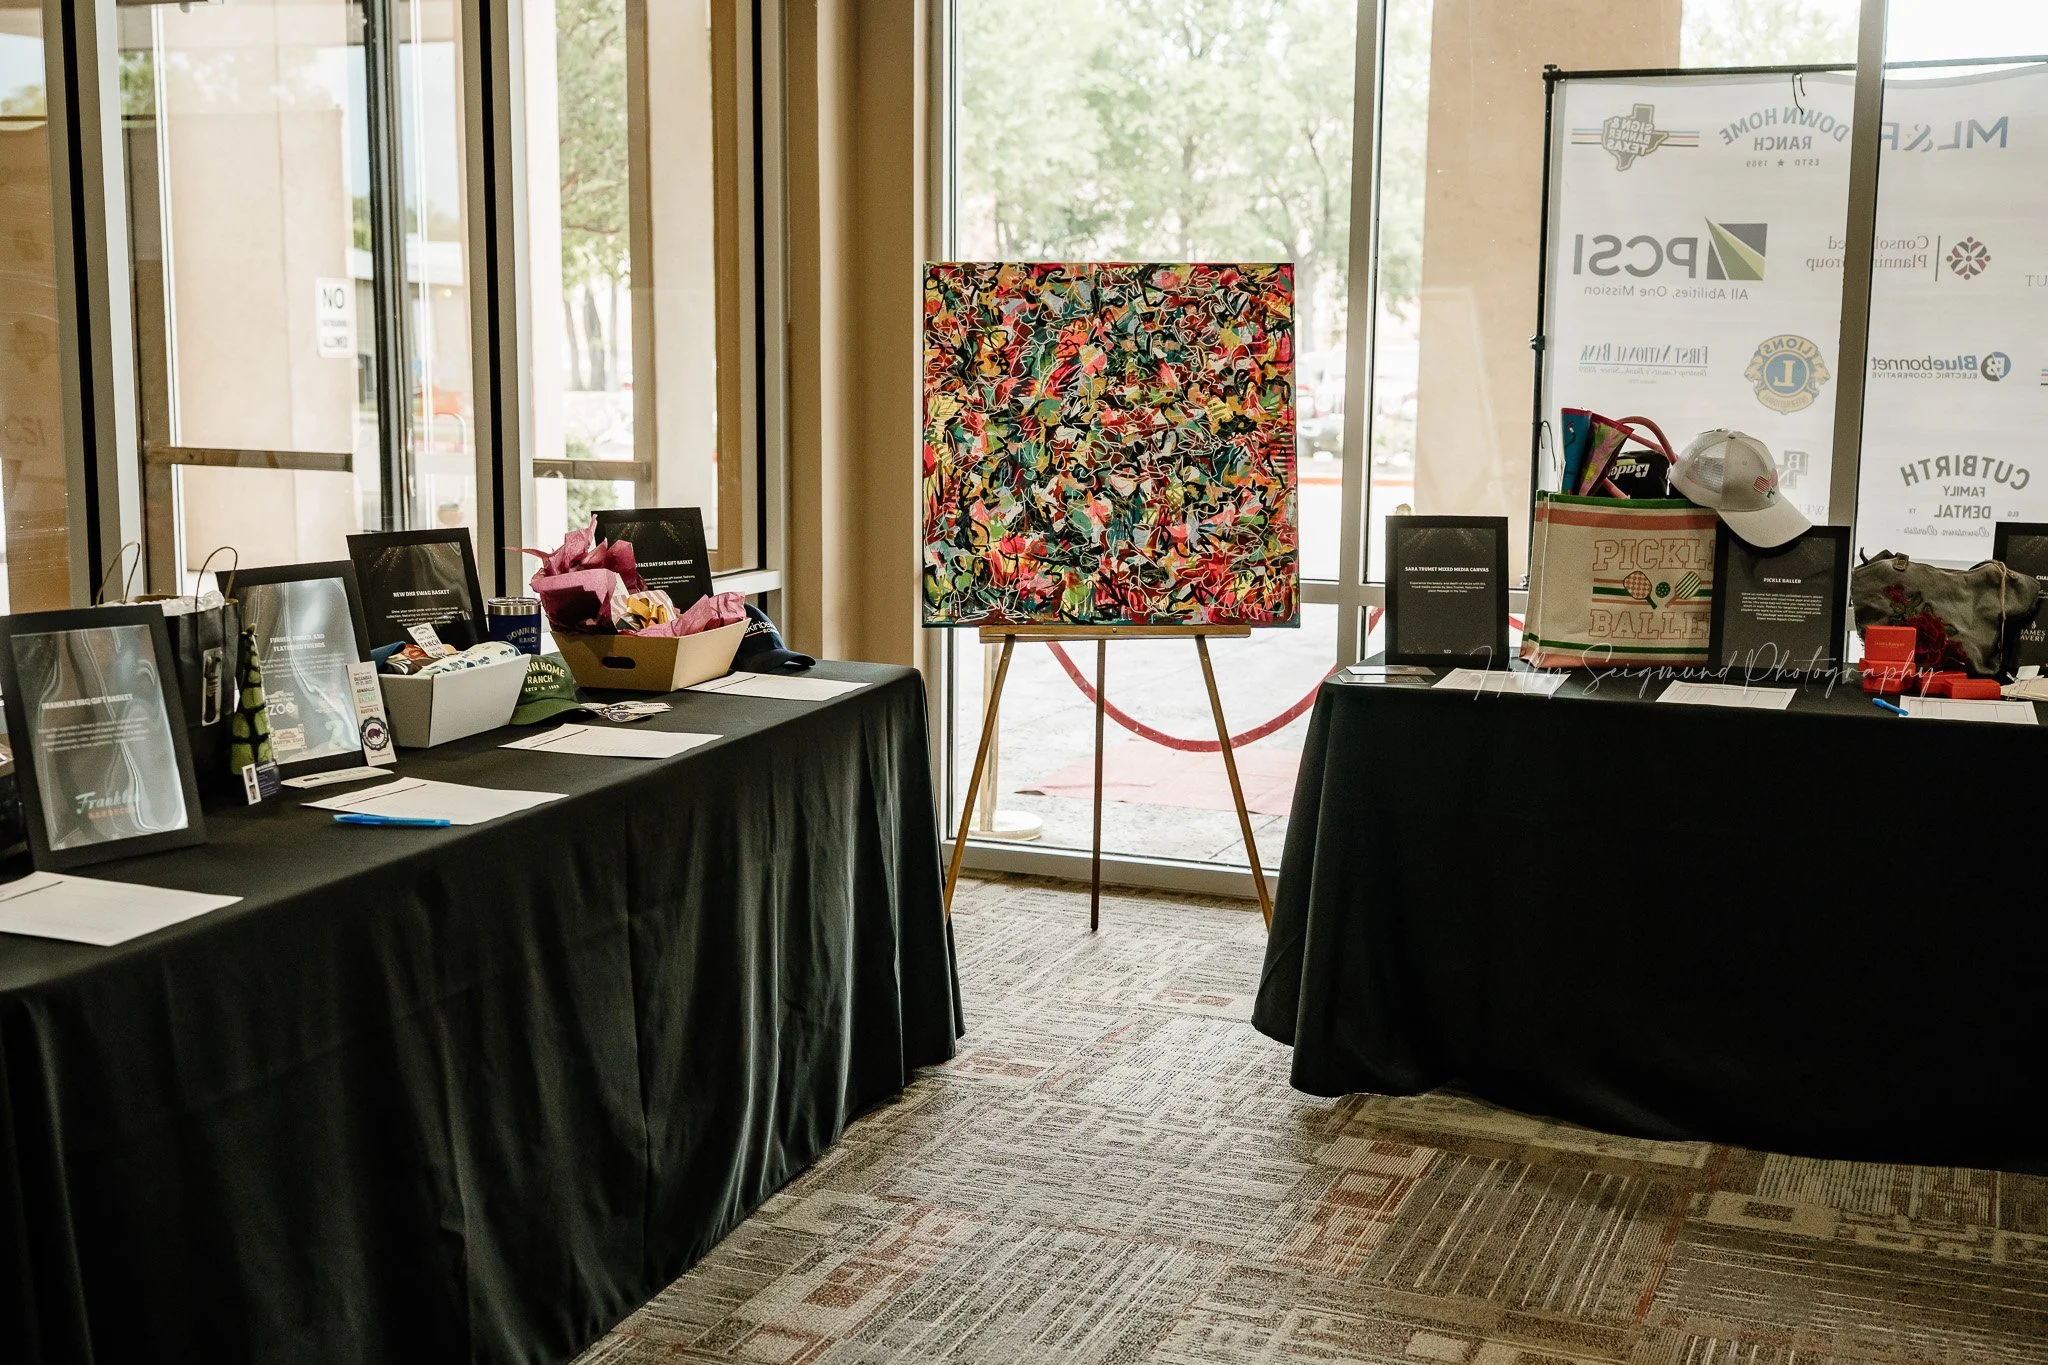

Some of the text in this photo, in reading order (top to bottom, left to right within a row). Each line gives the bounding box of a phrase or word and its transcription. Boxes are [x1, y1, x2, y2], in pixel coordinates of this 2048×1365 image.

[322, 287, 345, 309] NO
[1589, 609, 1710, 639] BALLE
[506, 627, 530, 642] DOWN
[2020, 628, 2046, 637] JAMES
[2020, 634, 2045, 643] AVERY
[540, 661, 565, 678] HOME
[527, 675, 553, 684] RANCH
[267, 702, 297, 716] ZOO
